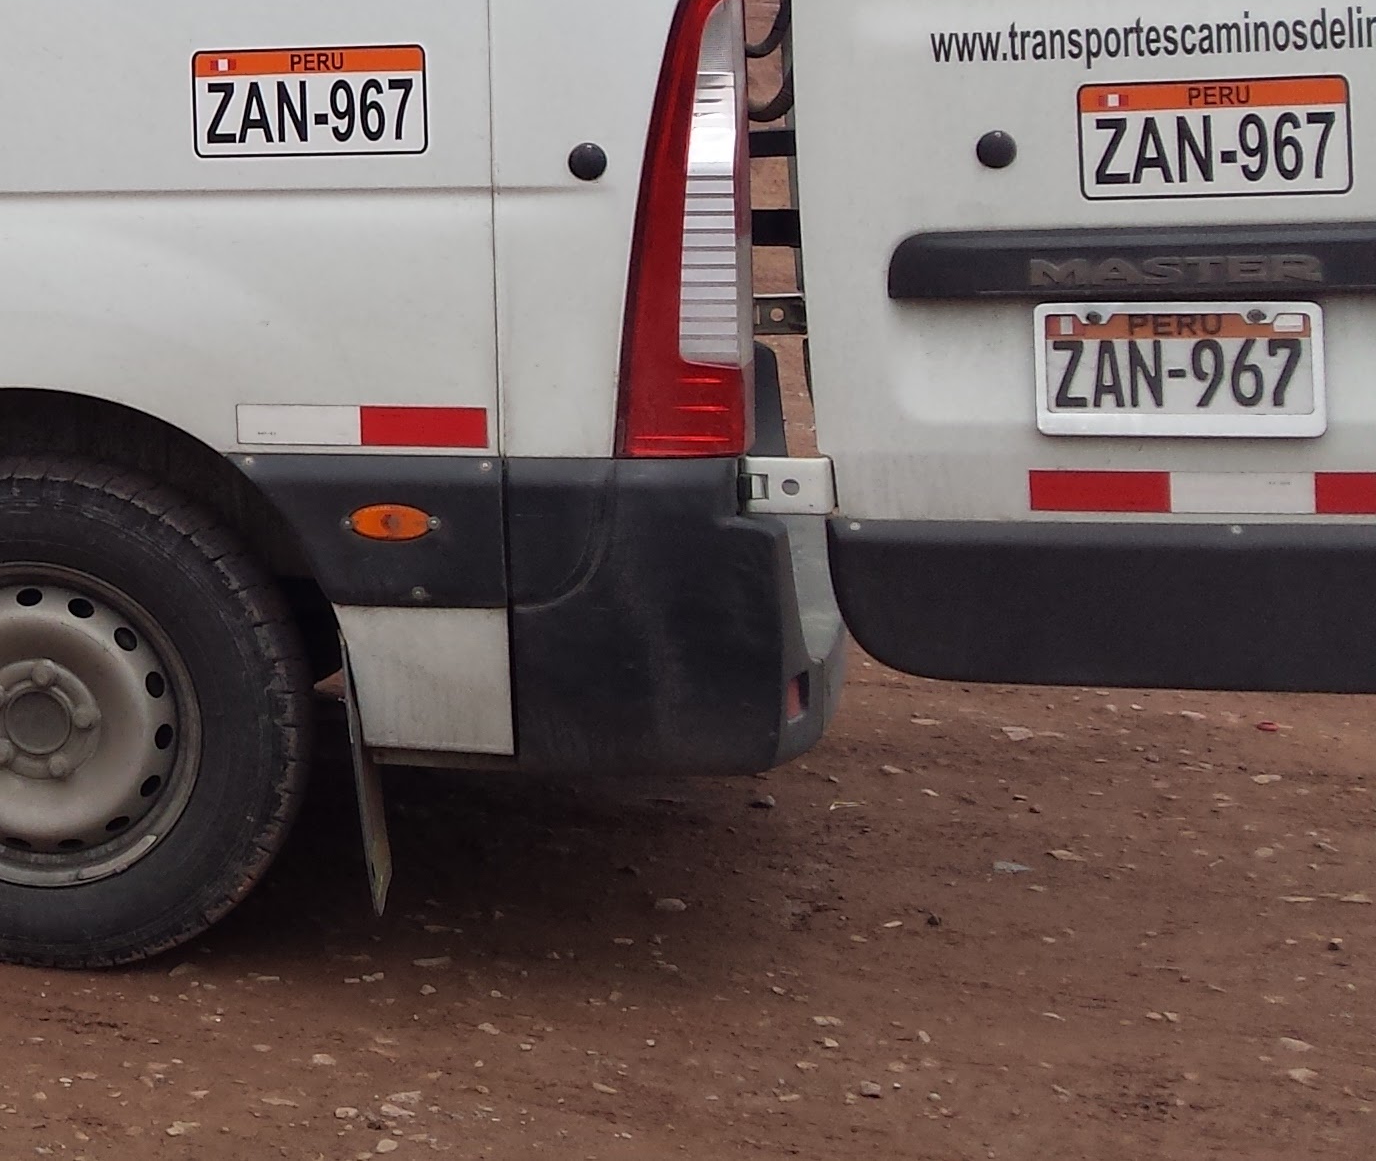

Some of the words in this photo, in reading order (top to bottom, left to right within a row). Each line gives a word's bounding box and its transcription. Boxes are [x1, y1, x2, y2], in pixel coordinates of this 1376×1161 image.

[290, 52, 344, 71] PERU
[207, 78, 413, 144] ZAN-967
[1187, 85, 1251, 107] PERU
[1095, 110, 1336, 185] ZAN-967
[1030, 254, 1323, 286] MASTER
[1127, 313, 1222, 336] PERU
[1052, 338, 1303, 408] ZAN-967
